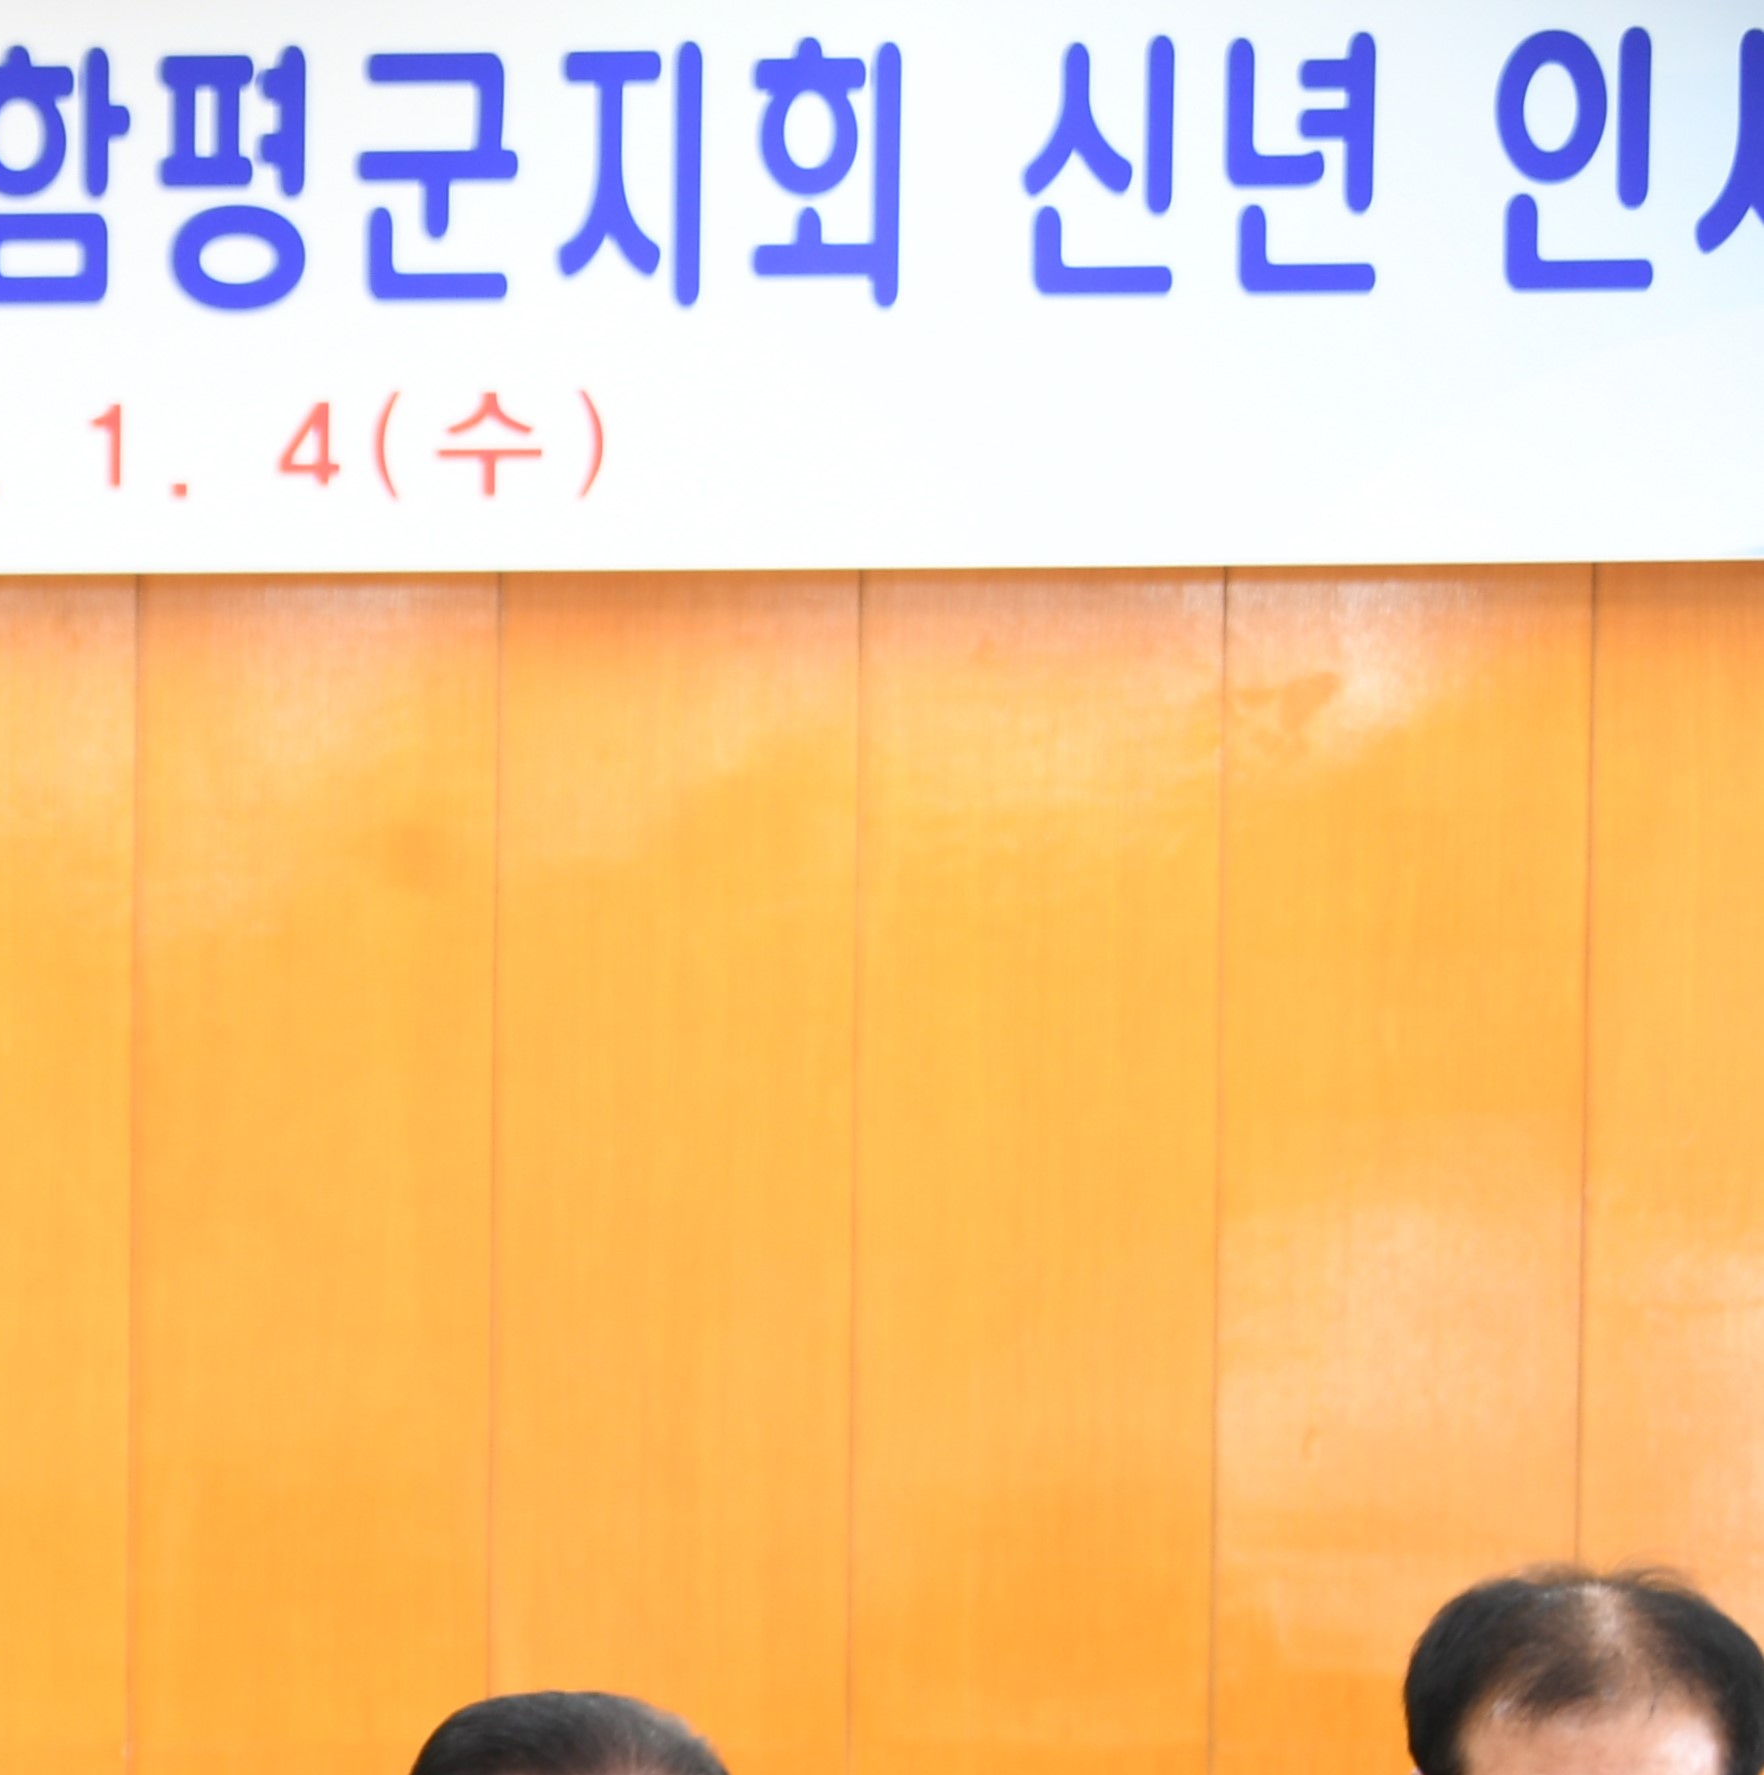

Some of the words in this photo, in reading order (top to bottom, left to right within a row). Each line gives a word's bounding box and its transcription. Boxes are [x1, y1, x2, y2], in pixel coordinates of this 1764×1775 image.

[1020, 32, 1379, 297] 신년
[89, 401, 190, 499] 1.
[276, 390, 606, 498] 4(수)
